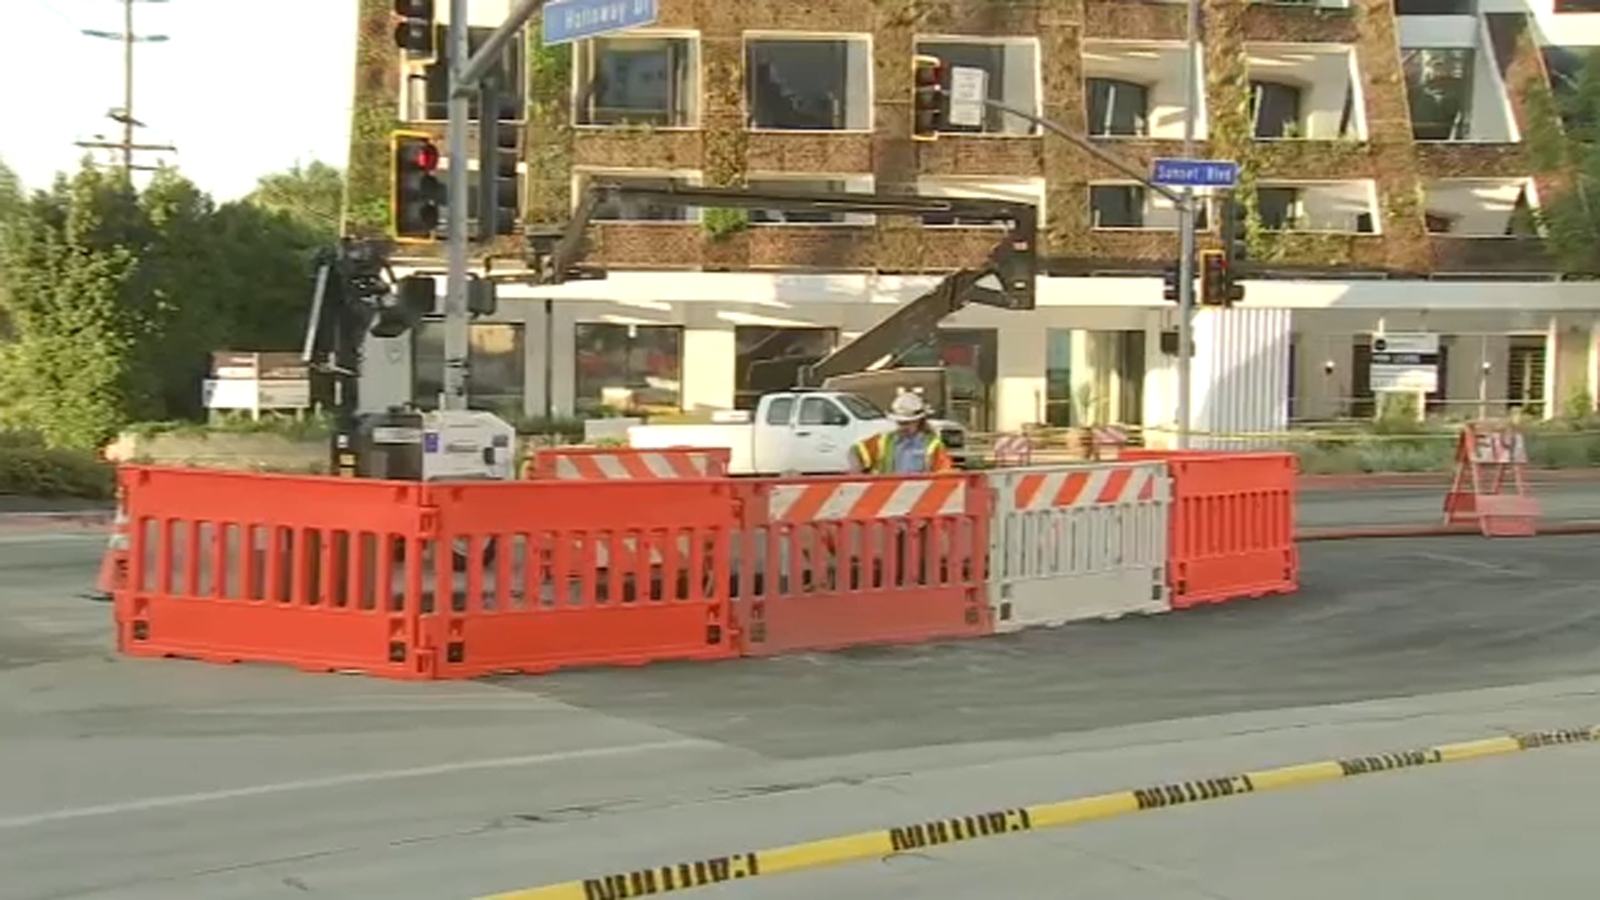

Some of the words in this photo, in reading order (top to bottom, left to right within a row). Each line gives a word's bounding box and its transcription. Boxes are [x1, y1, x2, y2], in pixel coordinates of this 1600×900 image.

[564, 2, 626, 29] Holloway
[1158, 165, 1199, 180] Sunset
[1207, 166, 1231, 182] Blvd
